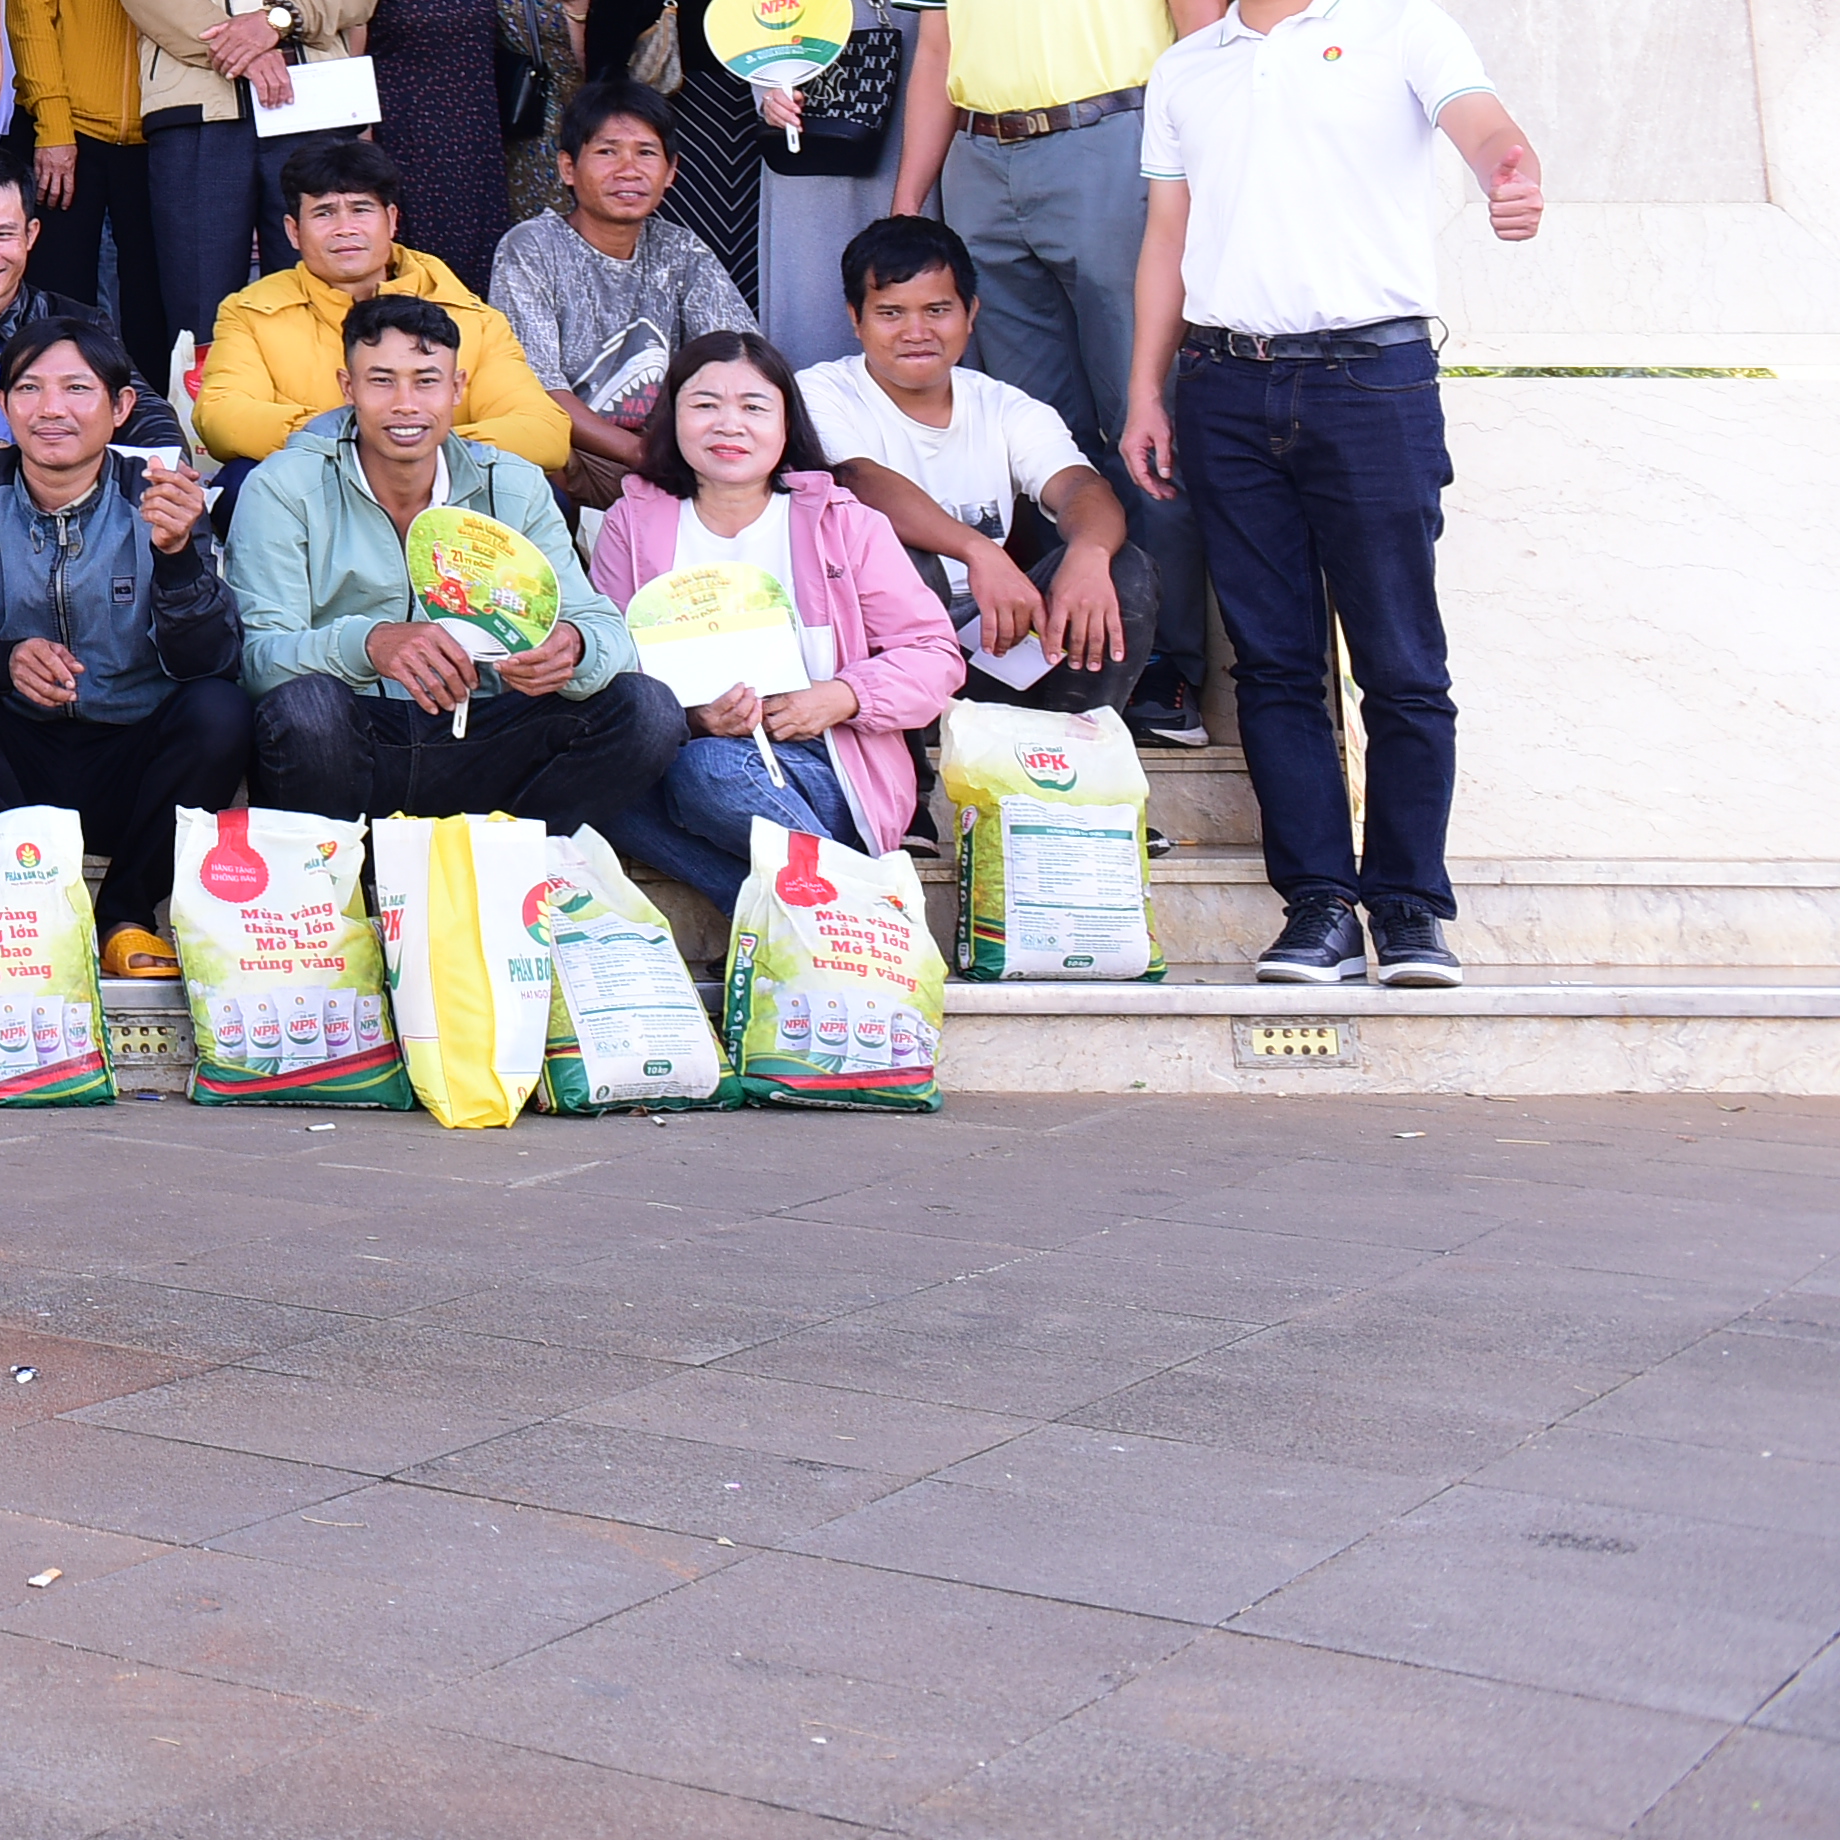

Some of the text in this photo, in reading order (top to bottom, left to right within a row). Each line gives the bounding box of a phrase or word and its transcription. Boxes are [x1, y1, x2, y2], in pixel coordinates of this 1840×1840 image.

[1022, 752, 1070, 771] NPK
[291, 903, 333, 921] vàng
[10, 924, 38, 939] lớn
[307, 918, 335, 935] lớn
[867, 917, 910, 938] vàng
[294, 939, 328, 949] bao
[883, 931, 910, 951] lớn
[1, 945, 32, 957] bao
[868, 947, 902, 965] bao
[7, 962, 52, 979] vàng
[239, 953, 345, 973] trúng vàng
[508, 957, 534, 983] PHÂN
[813, 956, 917, 992] trúng vàng
